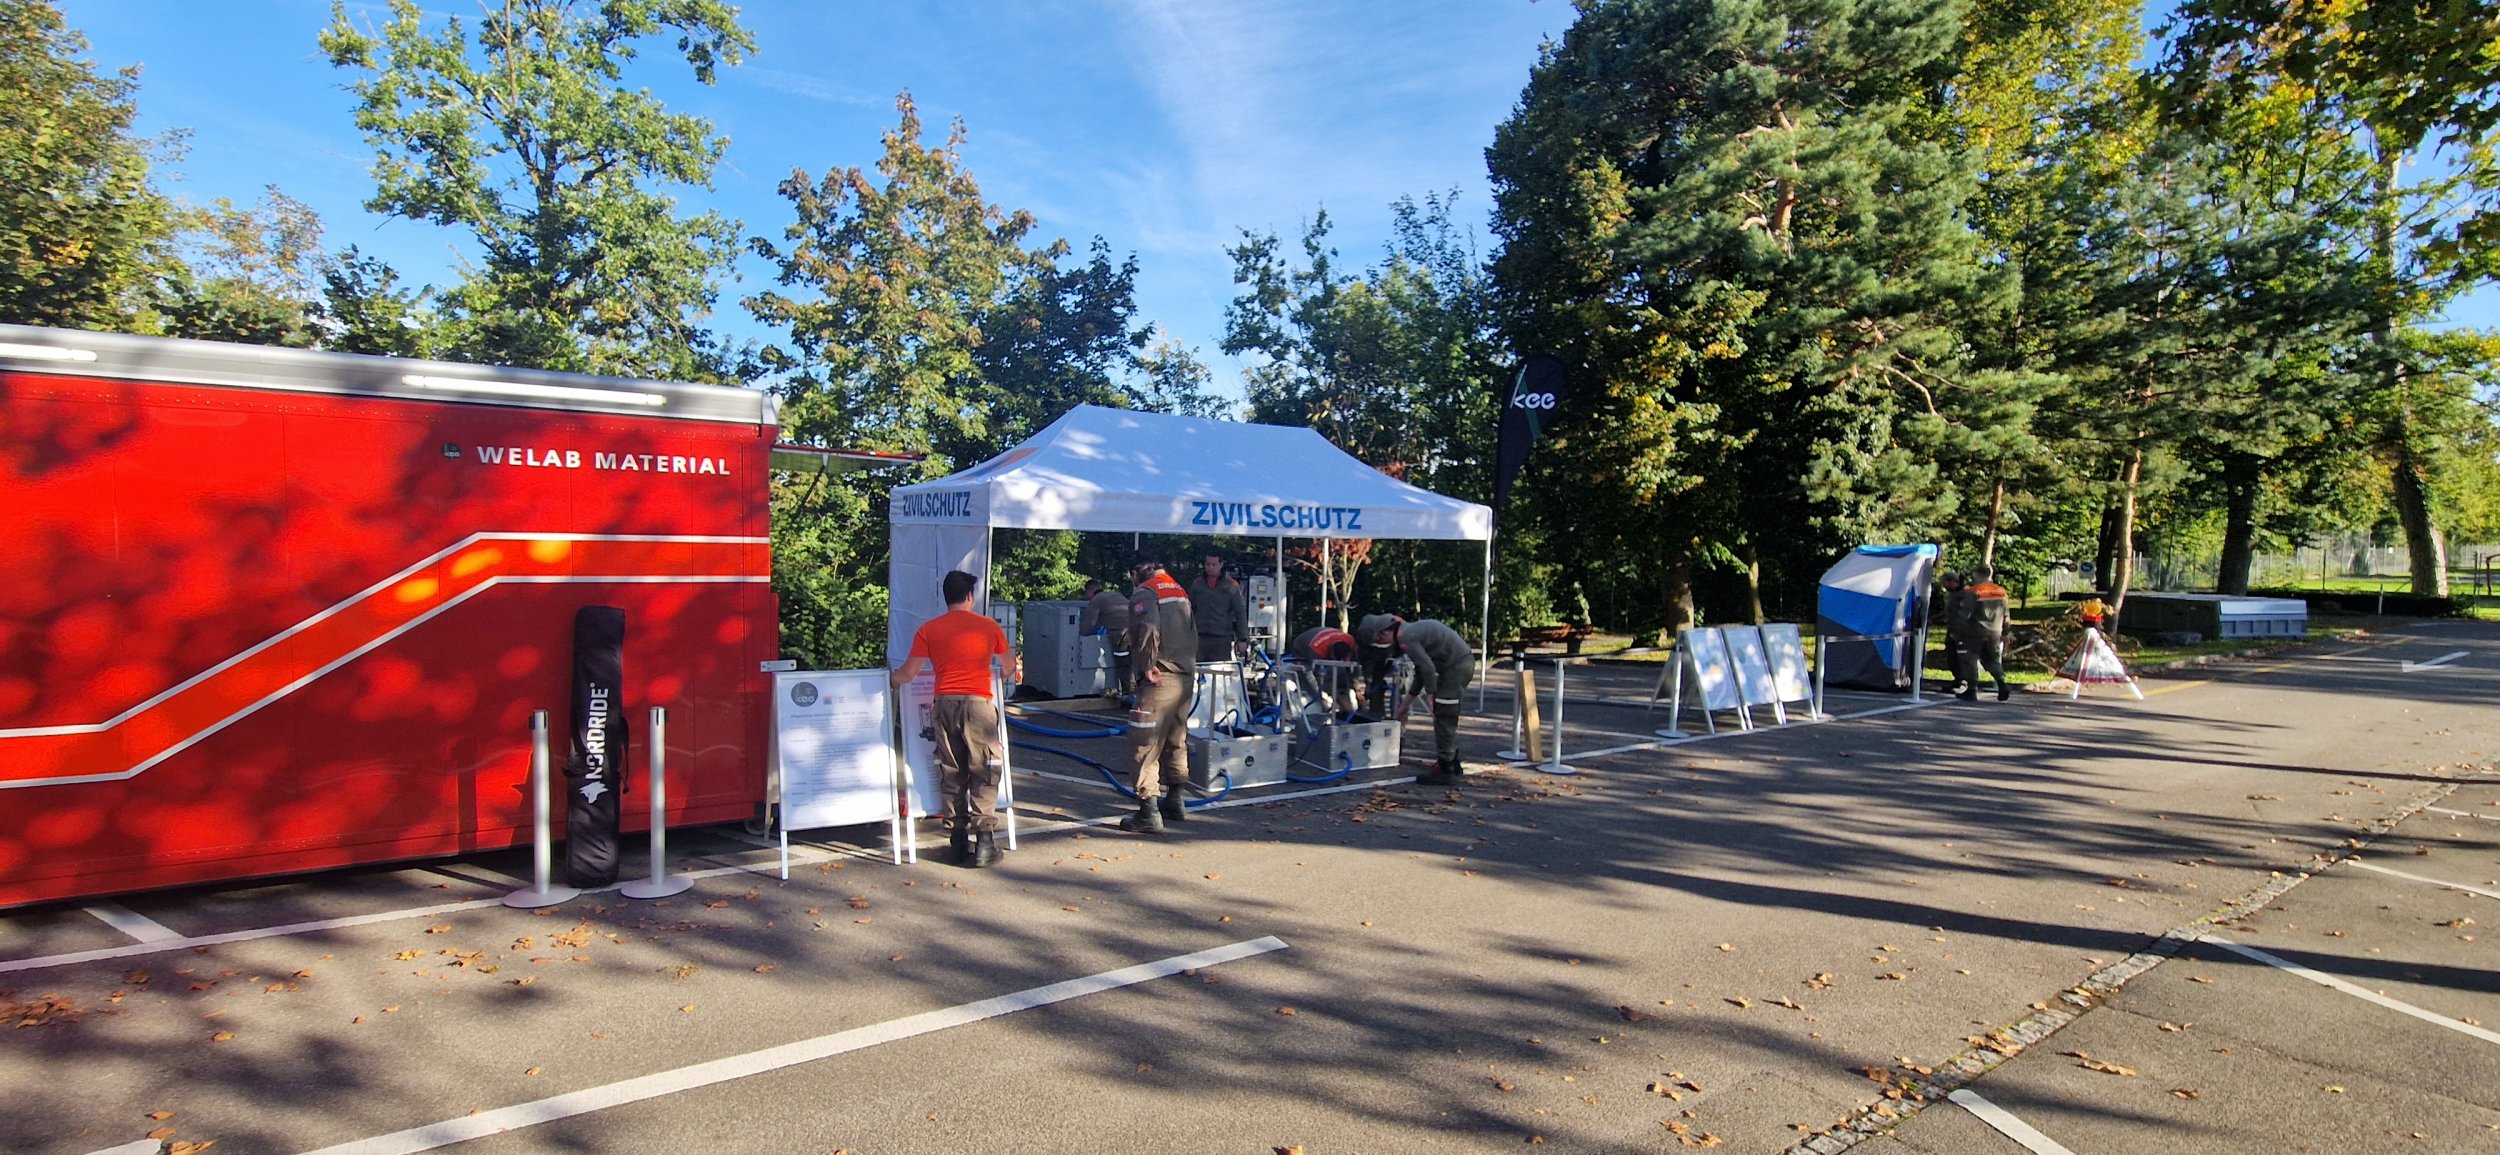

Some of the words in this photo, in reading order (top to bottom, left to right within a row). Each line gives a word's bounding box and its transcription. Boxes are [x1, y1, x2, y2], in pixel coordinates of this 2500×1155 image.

[1510, 364, 1556, 410] kee
[477, 446, 581, 468] WELAB
[595, 452, 731, 476] MATERIAL
[903, 491, 971, 517] ZIVILSCHUTZ
[1192, 501, 1362, 530] ZIVILSCHUTZ
